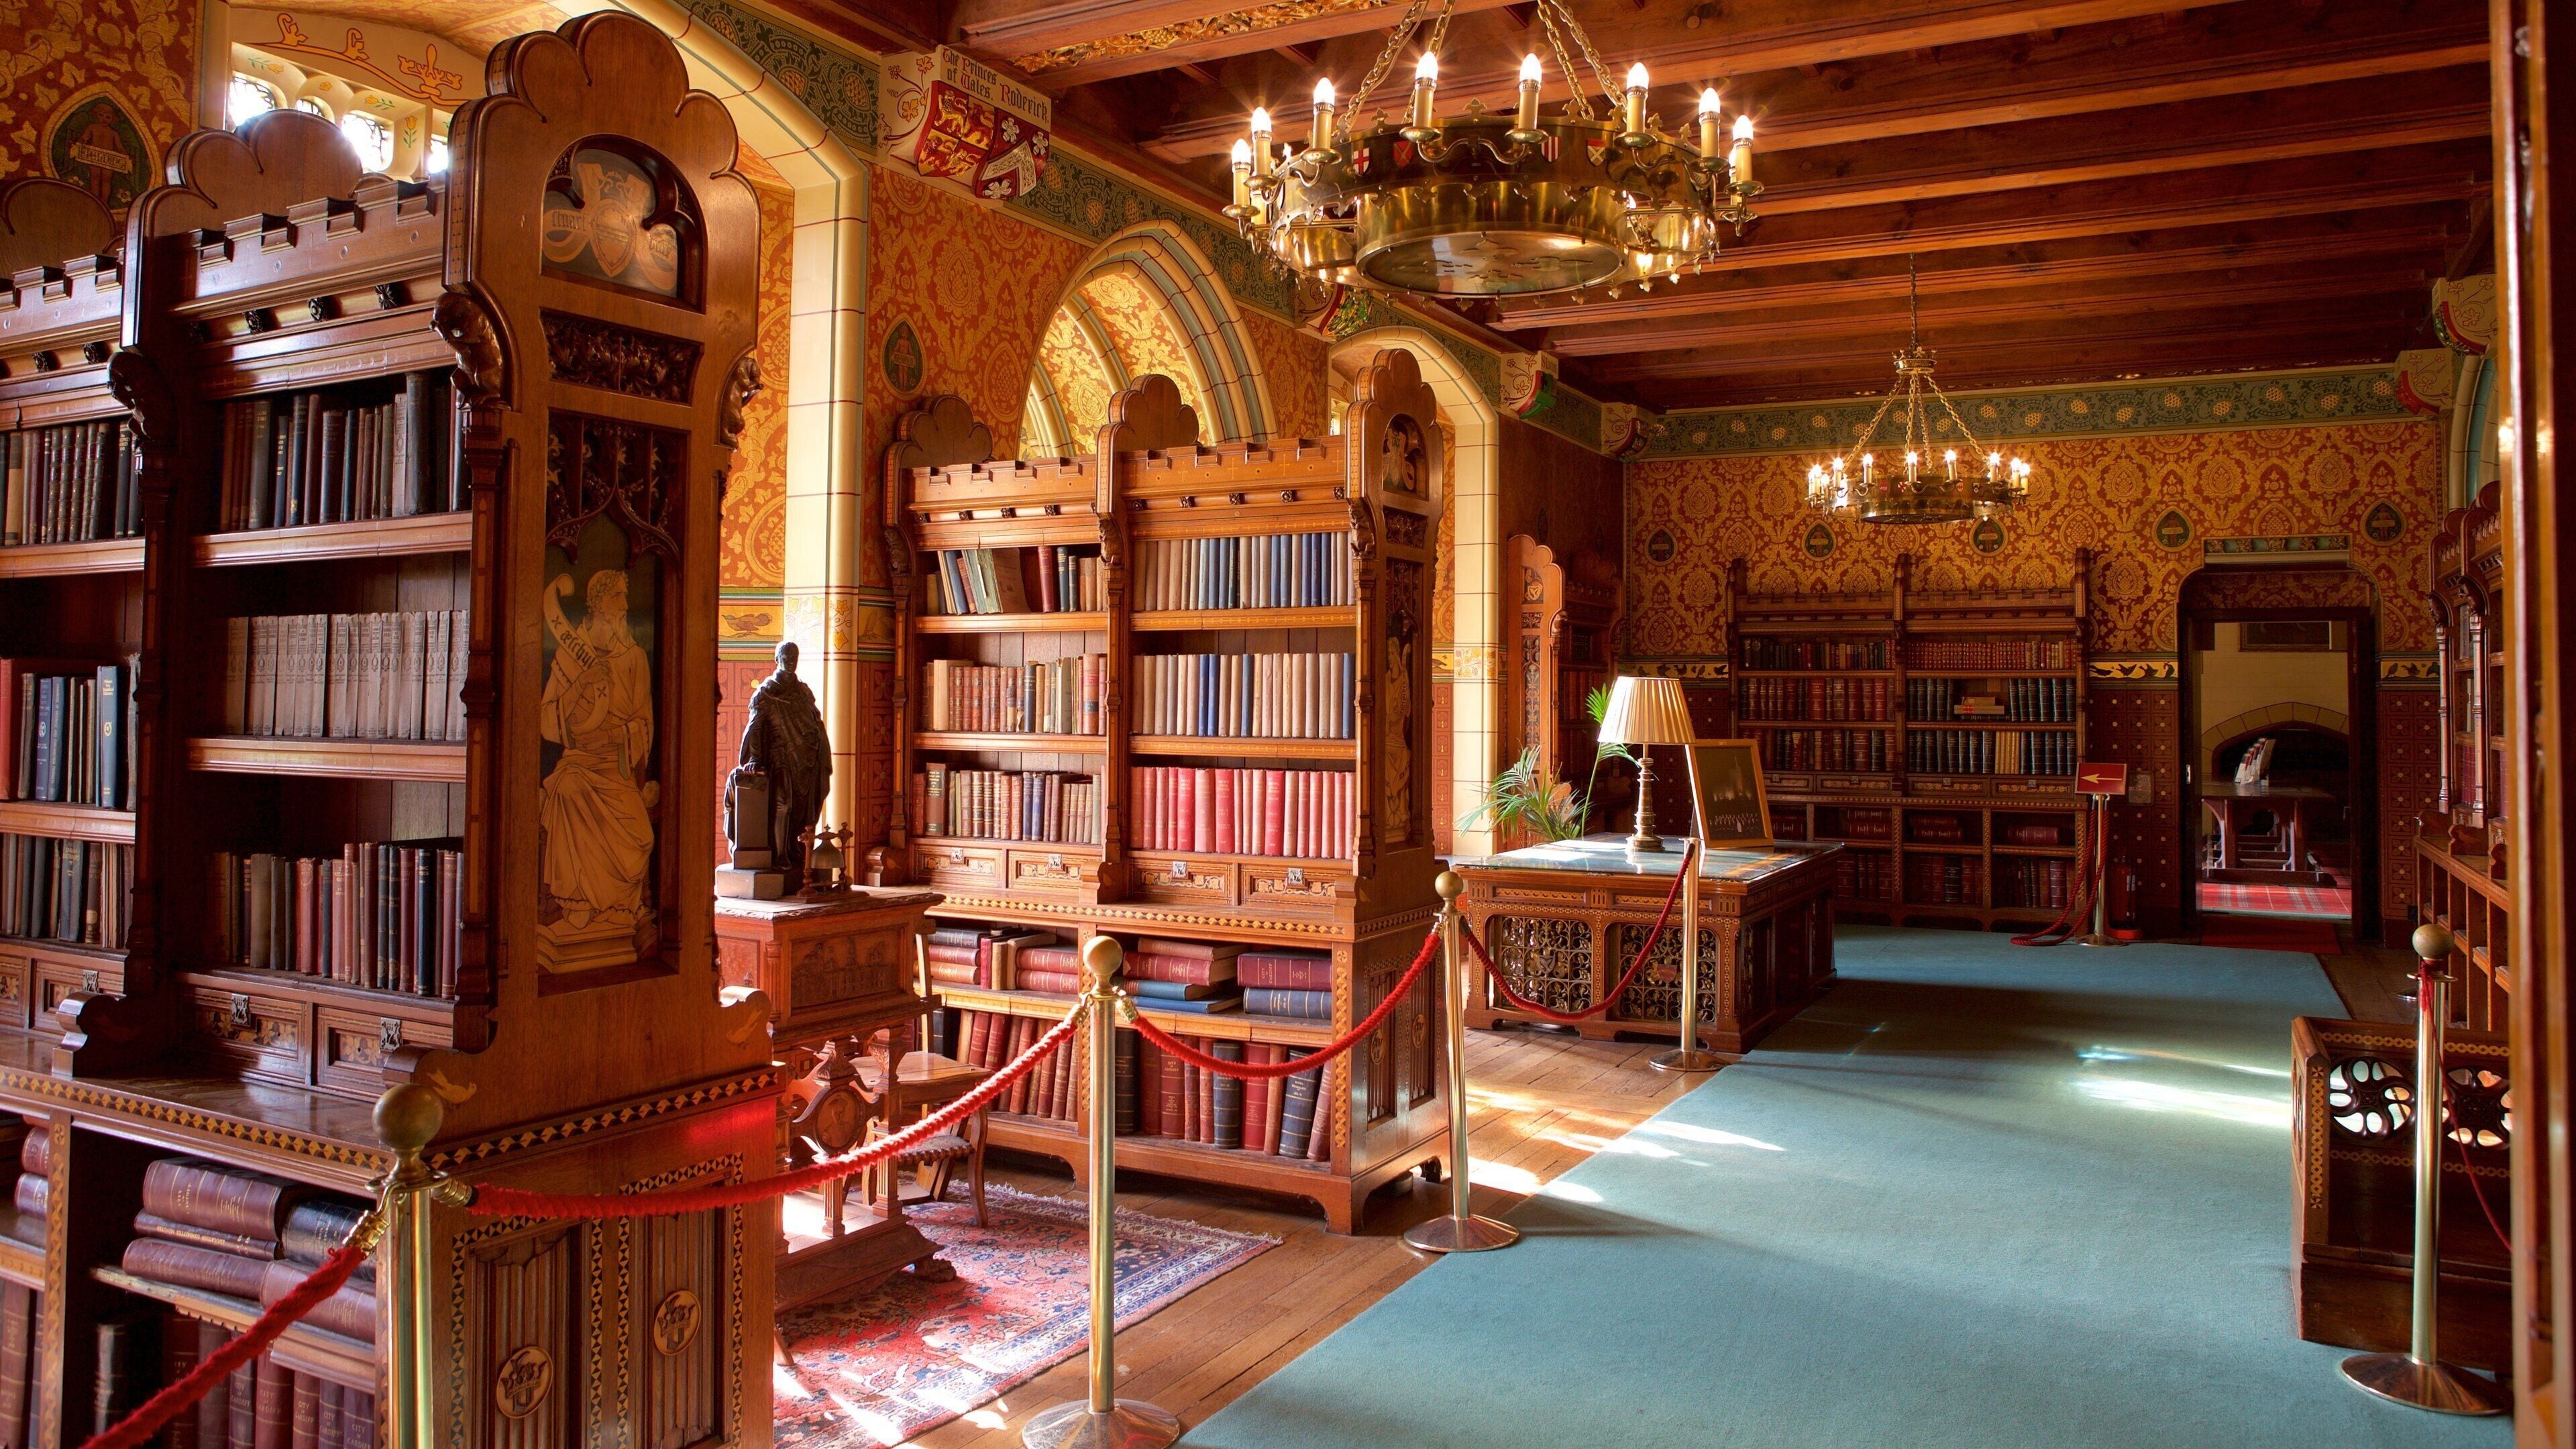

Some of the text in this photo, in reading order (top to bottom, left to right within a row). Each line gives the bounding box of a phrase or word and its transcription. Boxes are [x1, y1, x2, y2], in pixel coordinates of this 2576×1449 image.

[942, 48, 998, 86] The Princes
[947, 68, 958, 84] of
[352, 1423, 366, 1434] CITY
